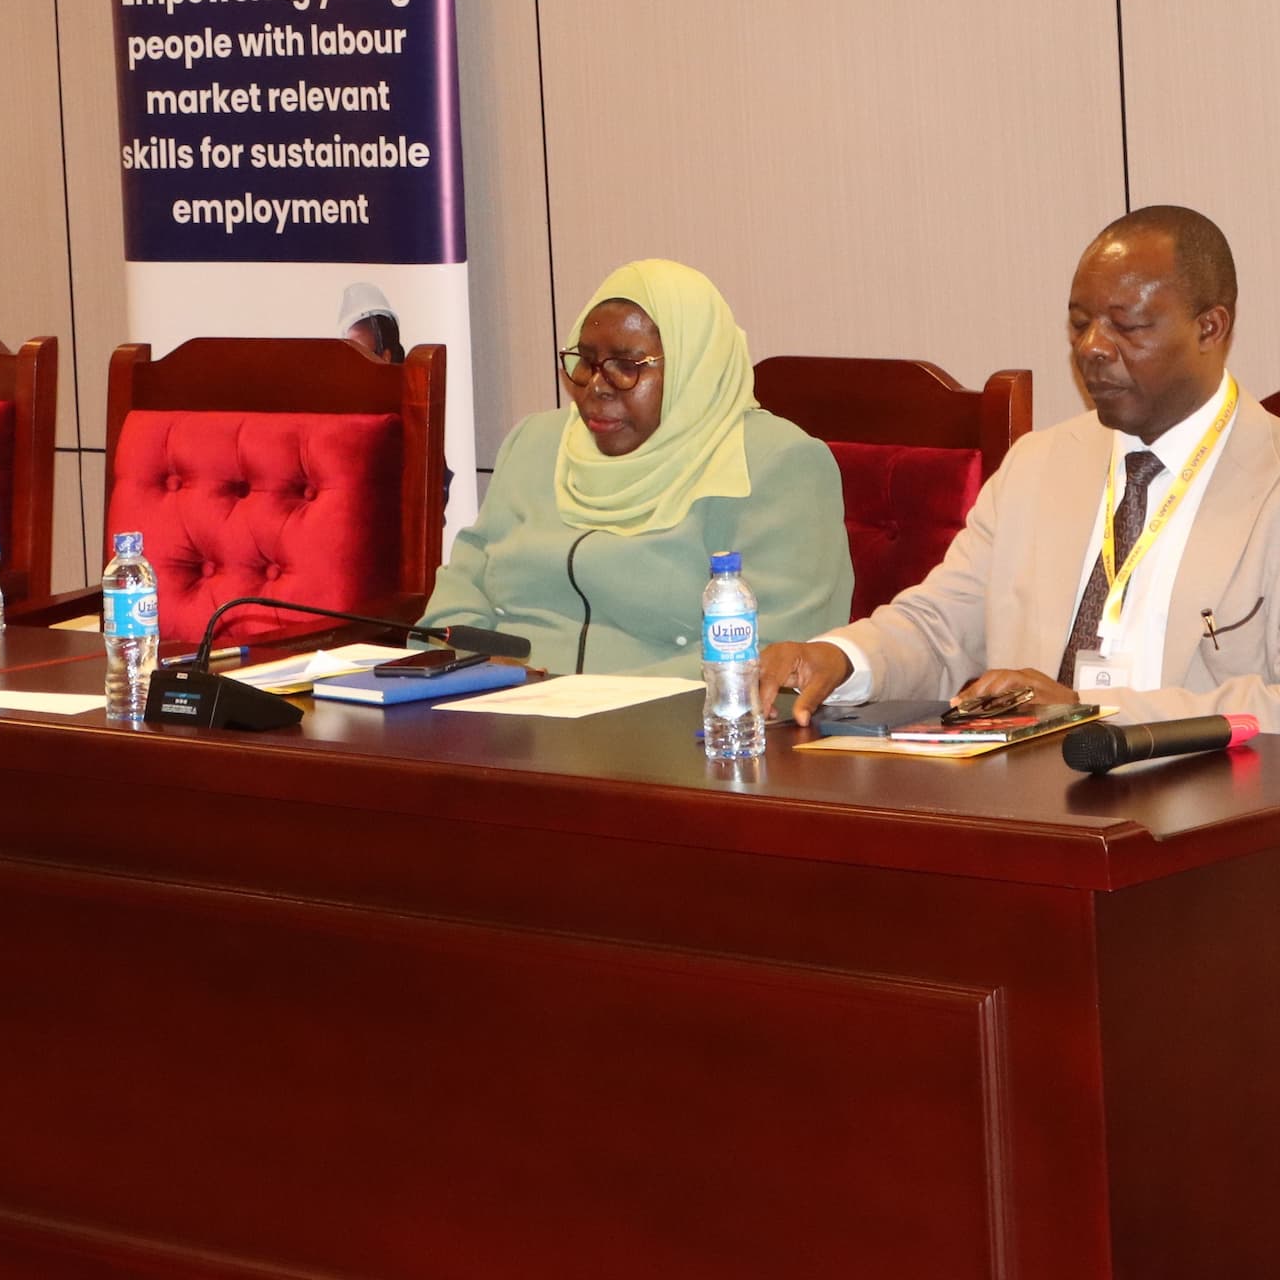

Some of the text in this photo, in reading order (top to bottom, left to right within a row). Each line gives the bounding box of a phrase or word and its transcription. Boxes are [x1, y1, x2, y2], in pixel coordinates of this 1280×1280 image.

[128, 23, 407, 70] people with labour
[147, 80, 390, 114] market relevant
[122, 134, 430, 170] skills for sustainable
[173, 192, 369, 233] employment
